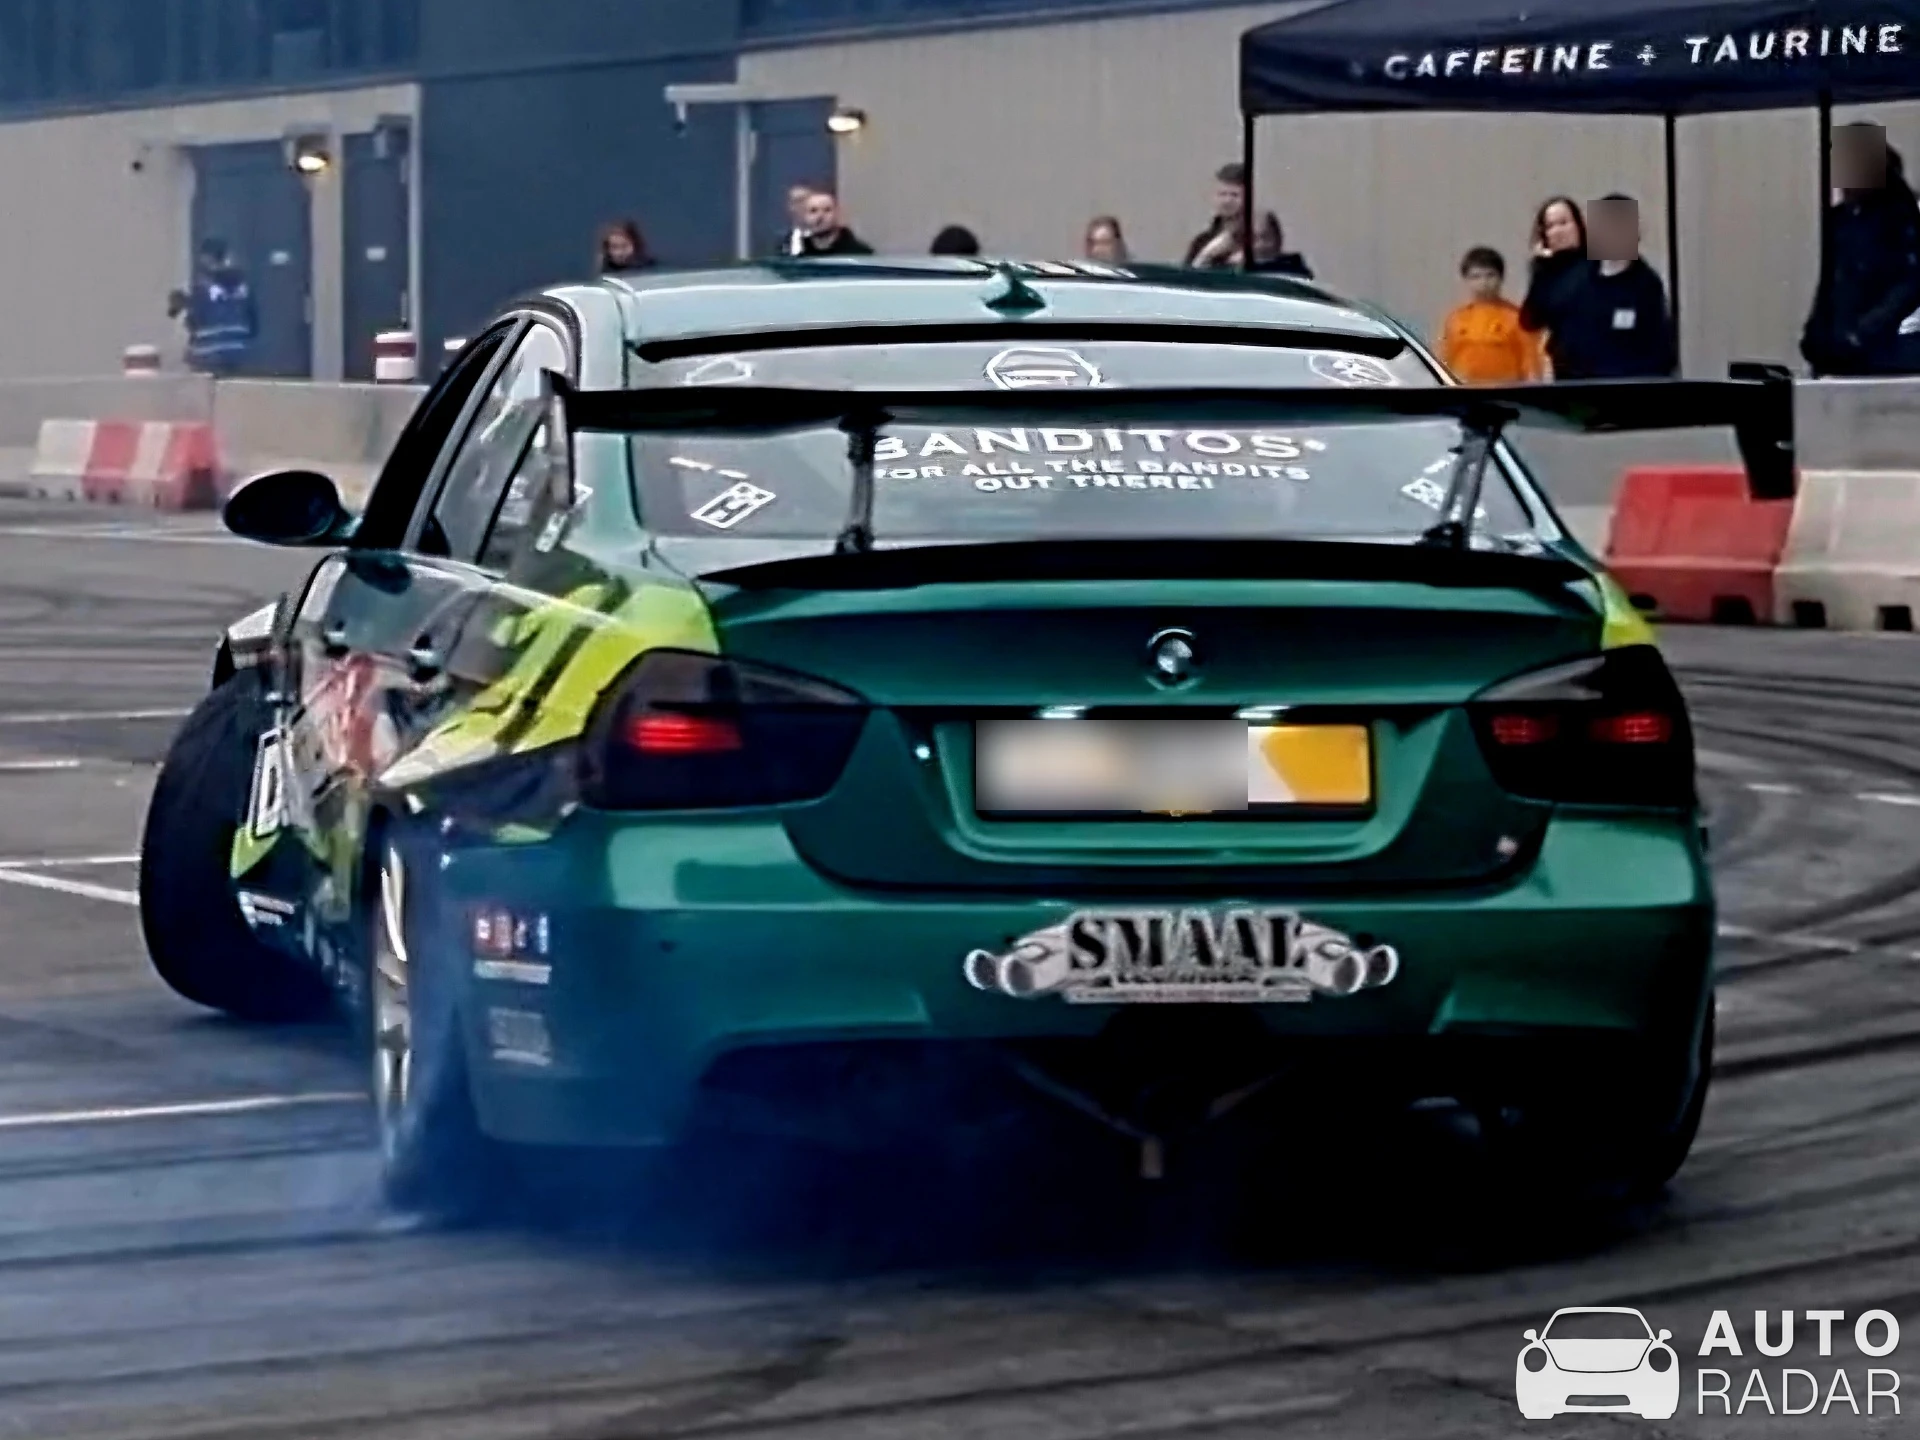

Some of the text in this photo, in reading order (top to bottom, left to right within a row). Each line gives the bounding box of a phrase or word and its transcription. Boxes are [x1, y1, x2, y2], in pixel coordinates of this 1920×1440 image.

[1384, 41, 1614, 81] CAFFEINE
[1685, 24, 1903, 64] TAURINE
[874, 427, 1300, 461] BANDITOS
[962, 461, 1035, 476] ALL
[1045, 459, 1125, 473] THE
[975, 475, 1053, 492] OUT
